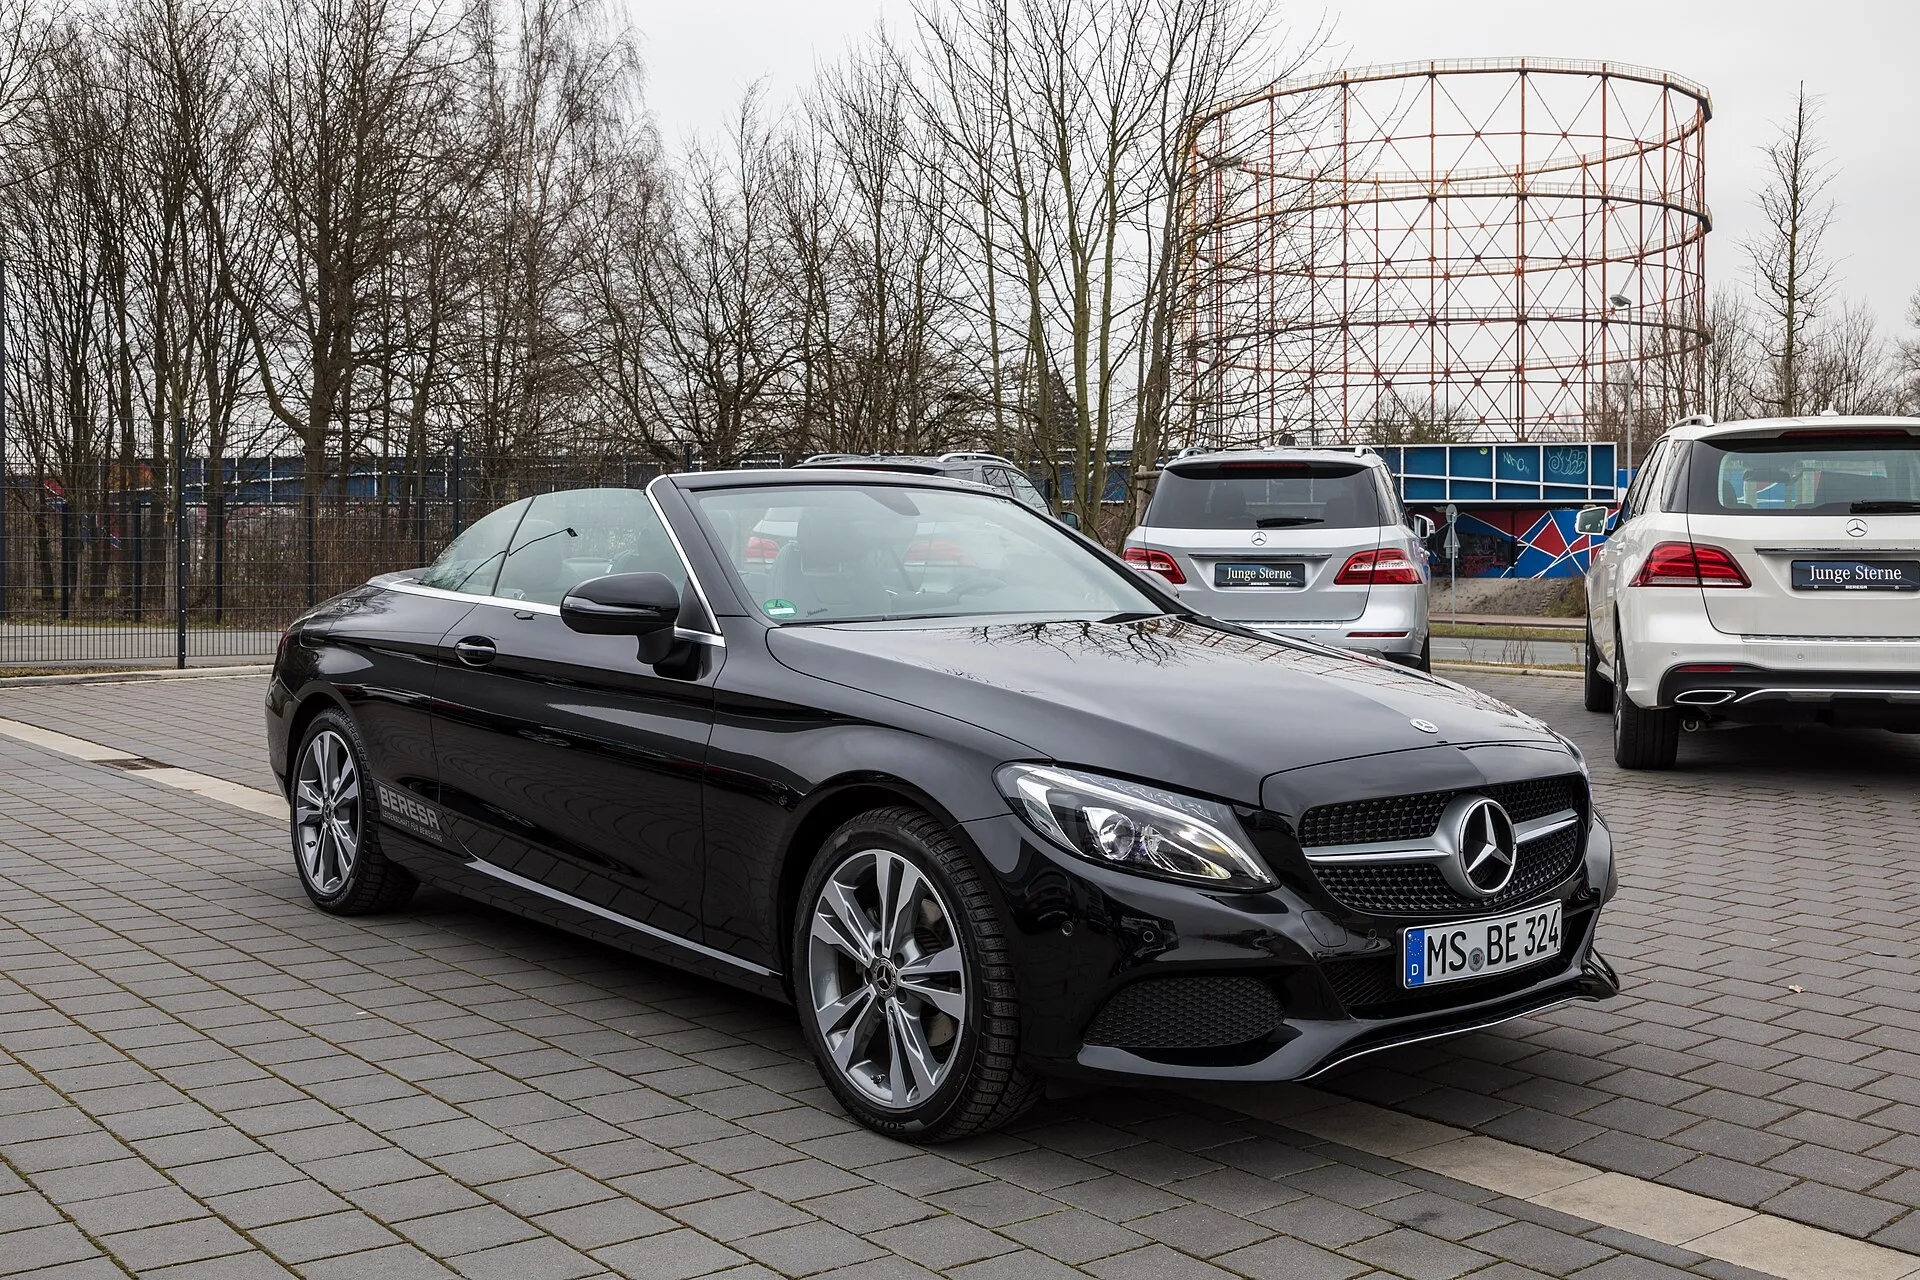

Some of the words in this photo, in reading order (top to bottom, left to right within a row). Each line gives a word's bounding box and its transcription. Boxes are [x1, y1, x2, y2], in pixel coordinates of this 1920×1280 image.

[1227, 567, 1256, 581] Junge
[1259, 567, 1292, 579] Sterne
[1810, 565, 1850, 583] Junge
[1855, 565, 1902, 580] Sterne
[379, 785, 440, 831] BERESA
[1427, 931, 1467, 976] MS
[1487, 921, 1518, 966] BE
[1524, 909, 1559, 957] 324
[1411, 963, 1419, 976] D
